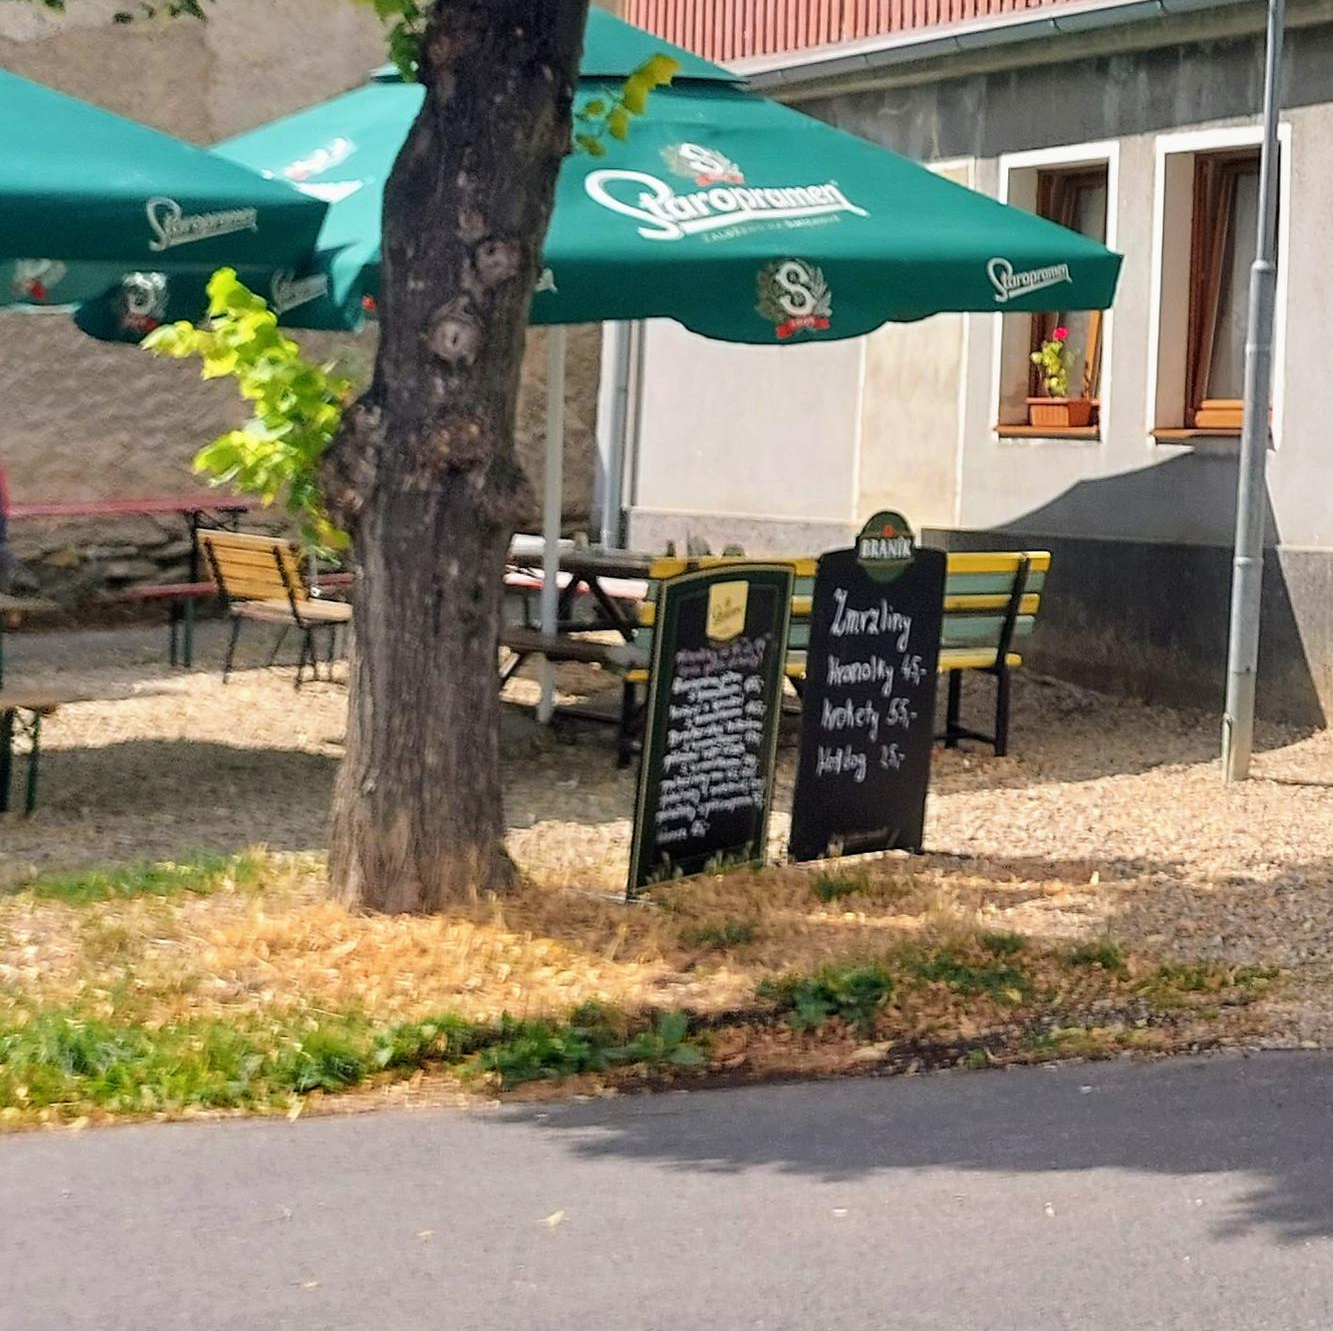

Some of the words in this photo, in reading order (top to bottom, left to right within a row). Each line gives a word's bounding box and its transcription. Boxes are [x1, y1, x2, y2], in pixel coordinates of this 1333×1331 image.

[584, 169, 871, 240] Staropramen
[986, 257, 1073, 303] Staropramen
[860, 535, 911, 559] BRANÍK
[829, 587, 912, 653] Zmrzliny
[821, 698, 880, 743] Krokety
